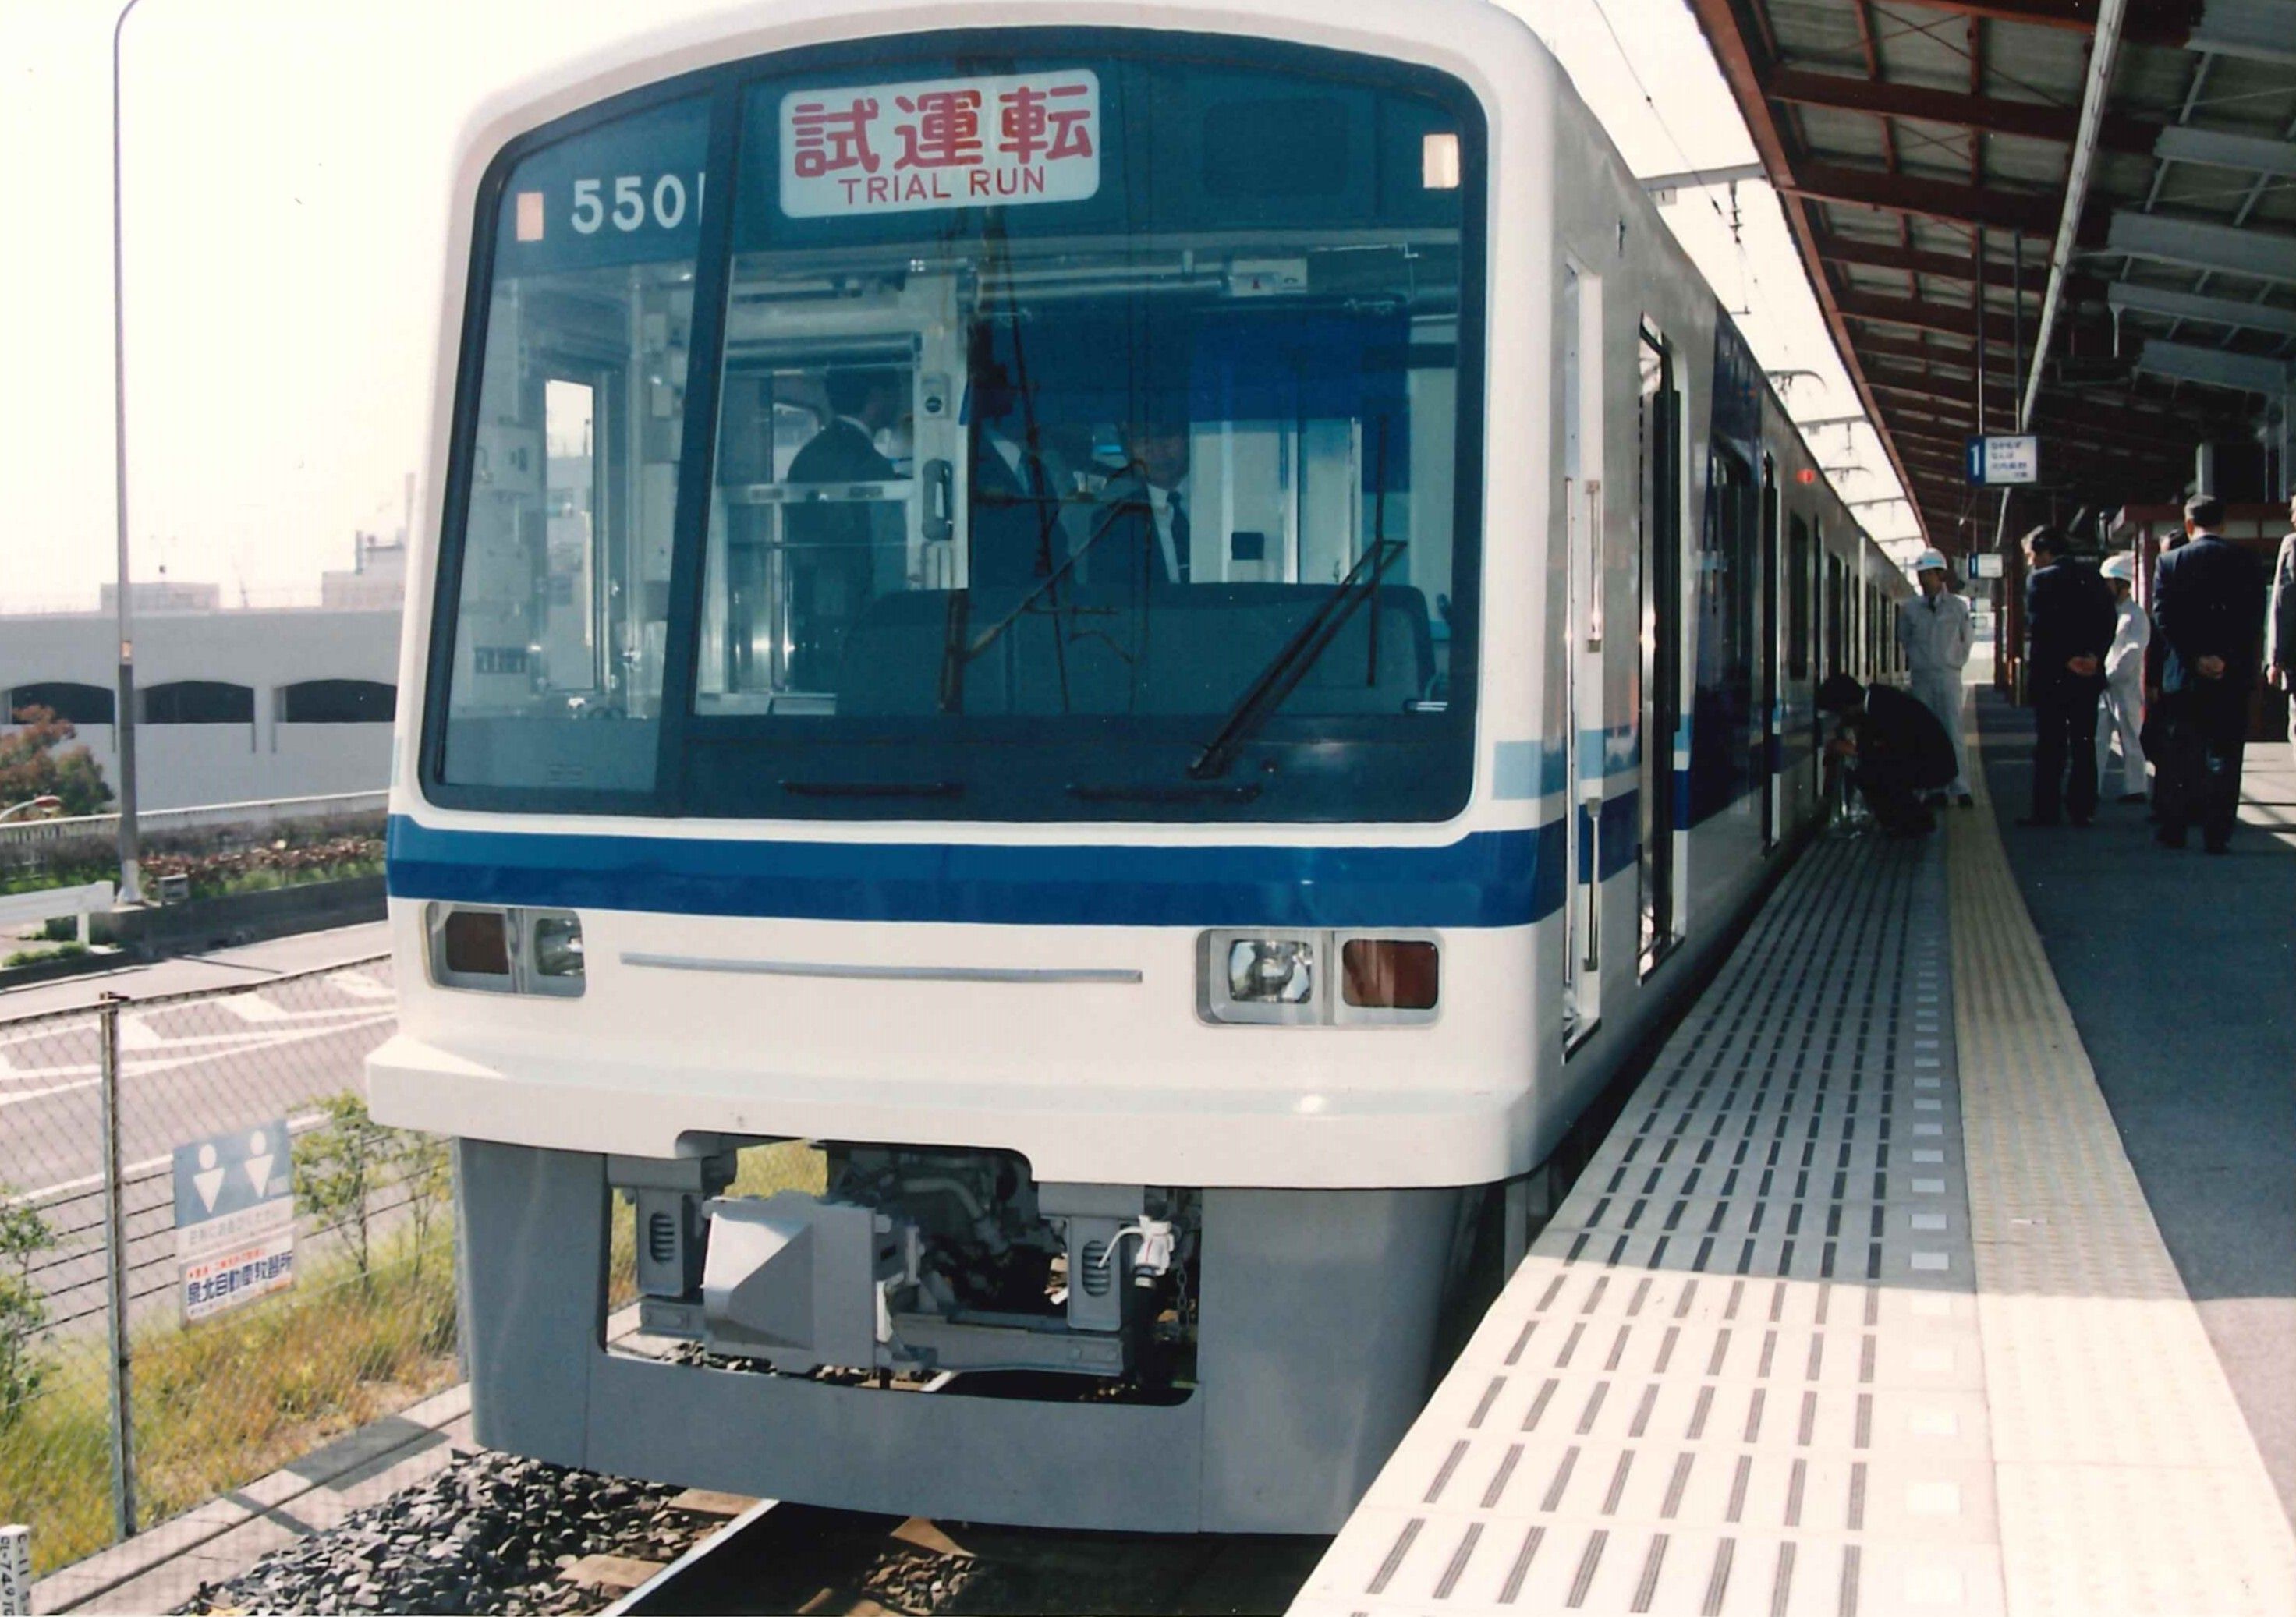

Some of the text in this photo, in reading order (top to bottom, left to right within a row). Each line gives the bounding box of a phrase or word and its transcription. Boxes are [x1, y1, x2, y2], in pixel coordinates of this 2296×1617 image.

[792, 84, 1093, 178] 試運転
[838, 165, 1045, 205] TRIAL RUN
[1971, 445, 1980, 476] 1
